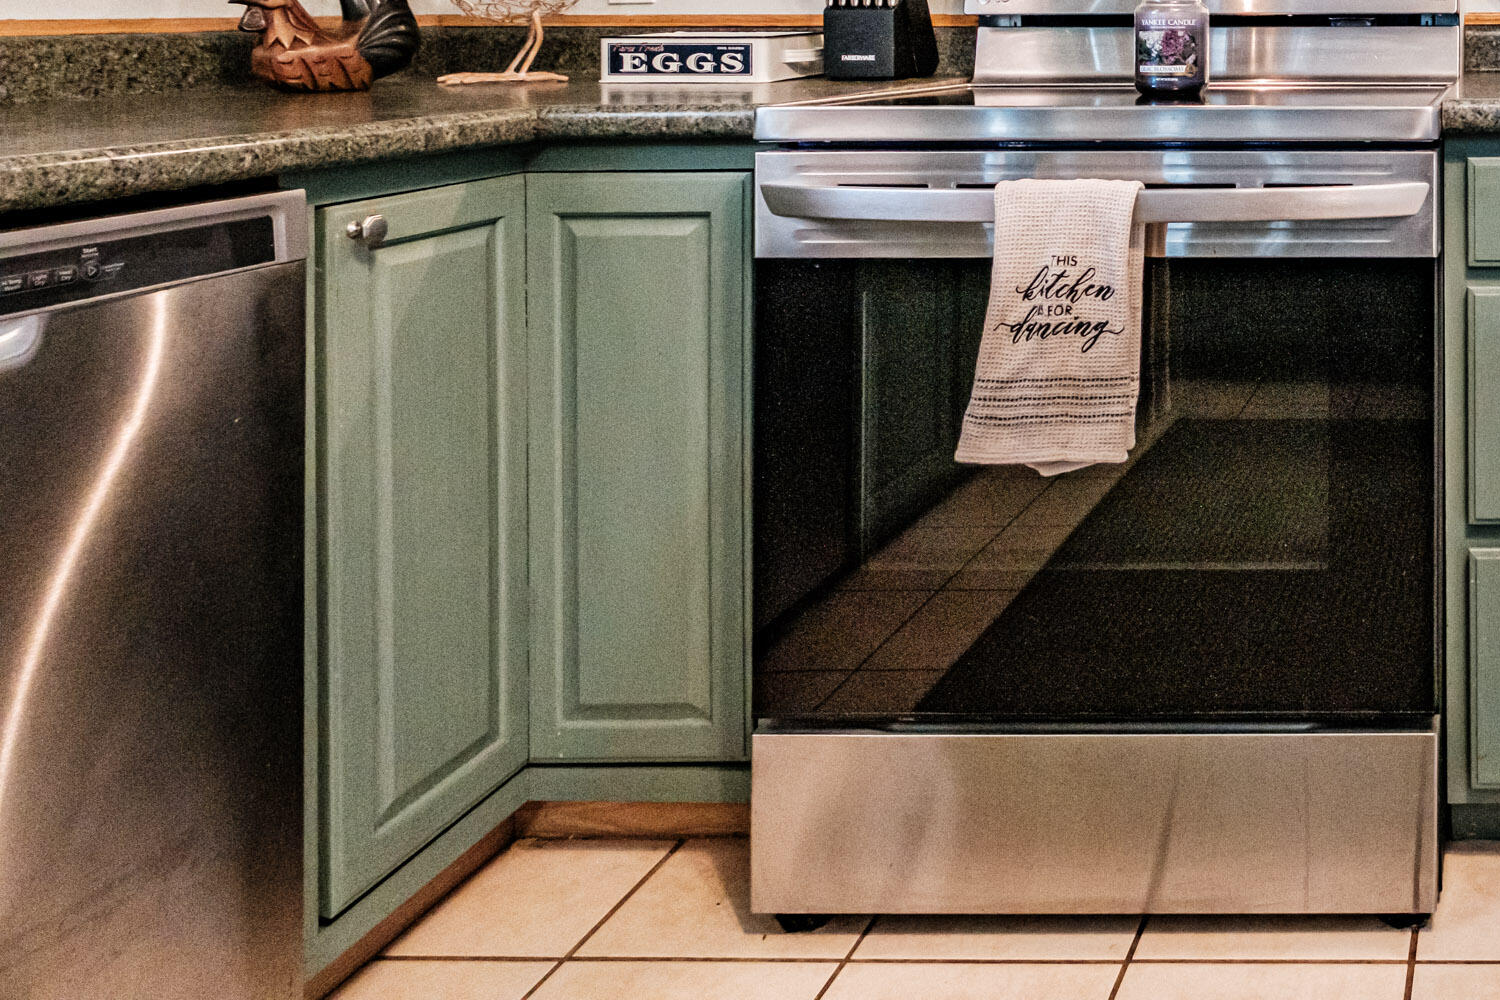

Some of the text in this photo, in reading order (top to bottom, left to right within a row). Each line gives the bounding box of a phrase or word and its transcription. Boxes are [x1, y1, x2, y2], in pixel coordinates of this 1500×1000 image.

[618, 52, 745, 73] EGGS
[1051, 255, 1078, 267] THIS
[1015, 265, 1115, 304] kitchen
[1047, 305, 1073, 317] FOR
[993, 305, 1125, 353] dancing
